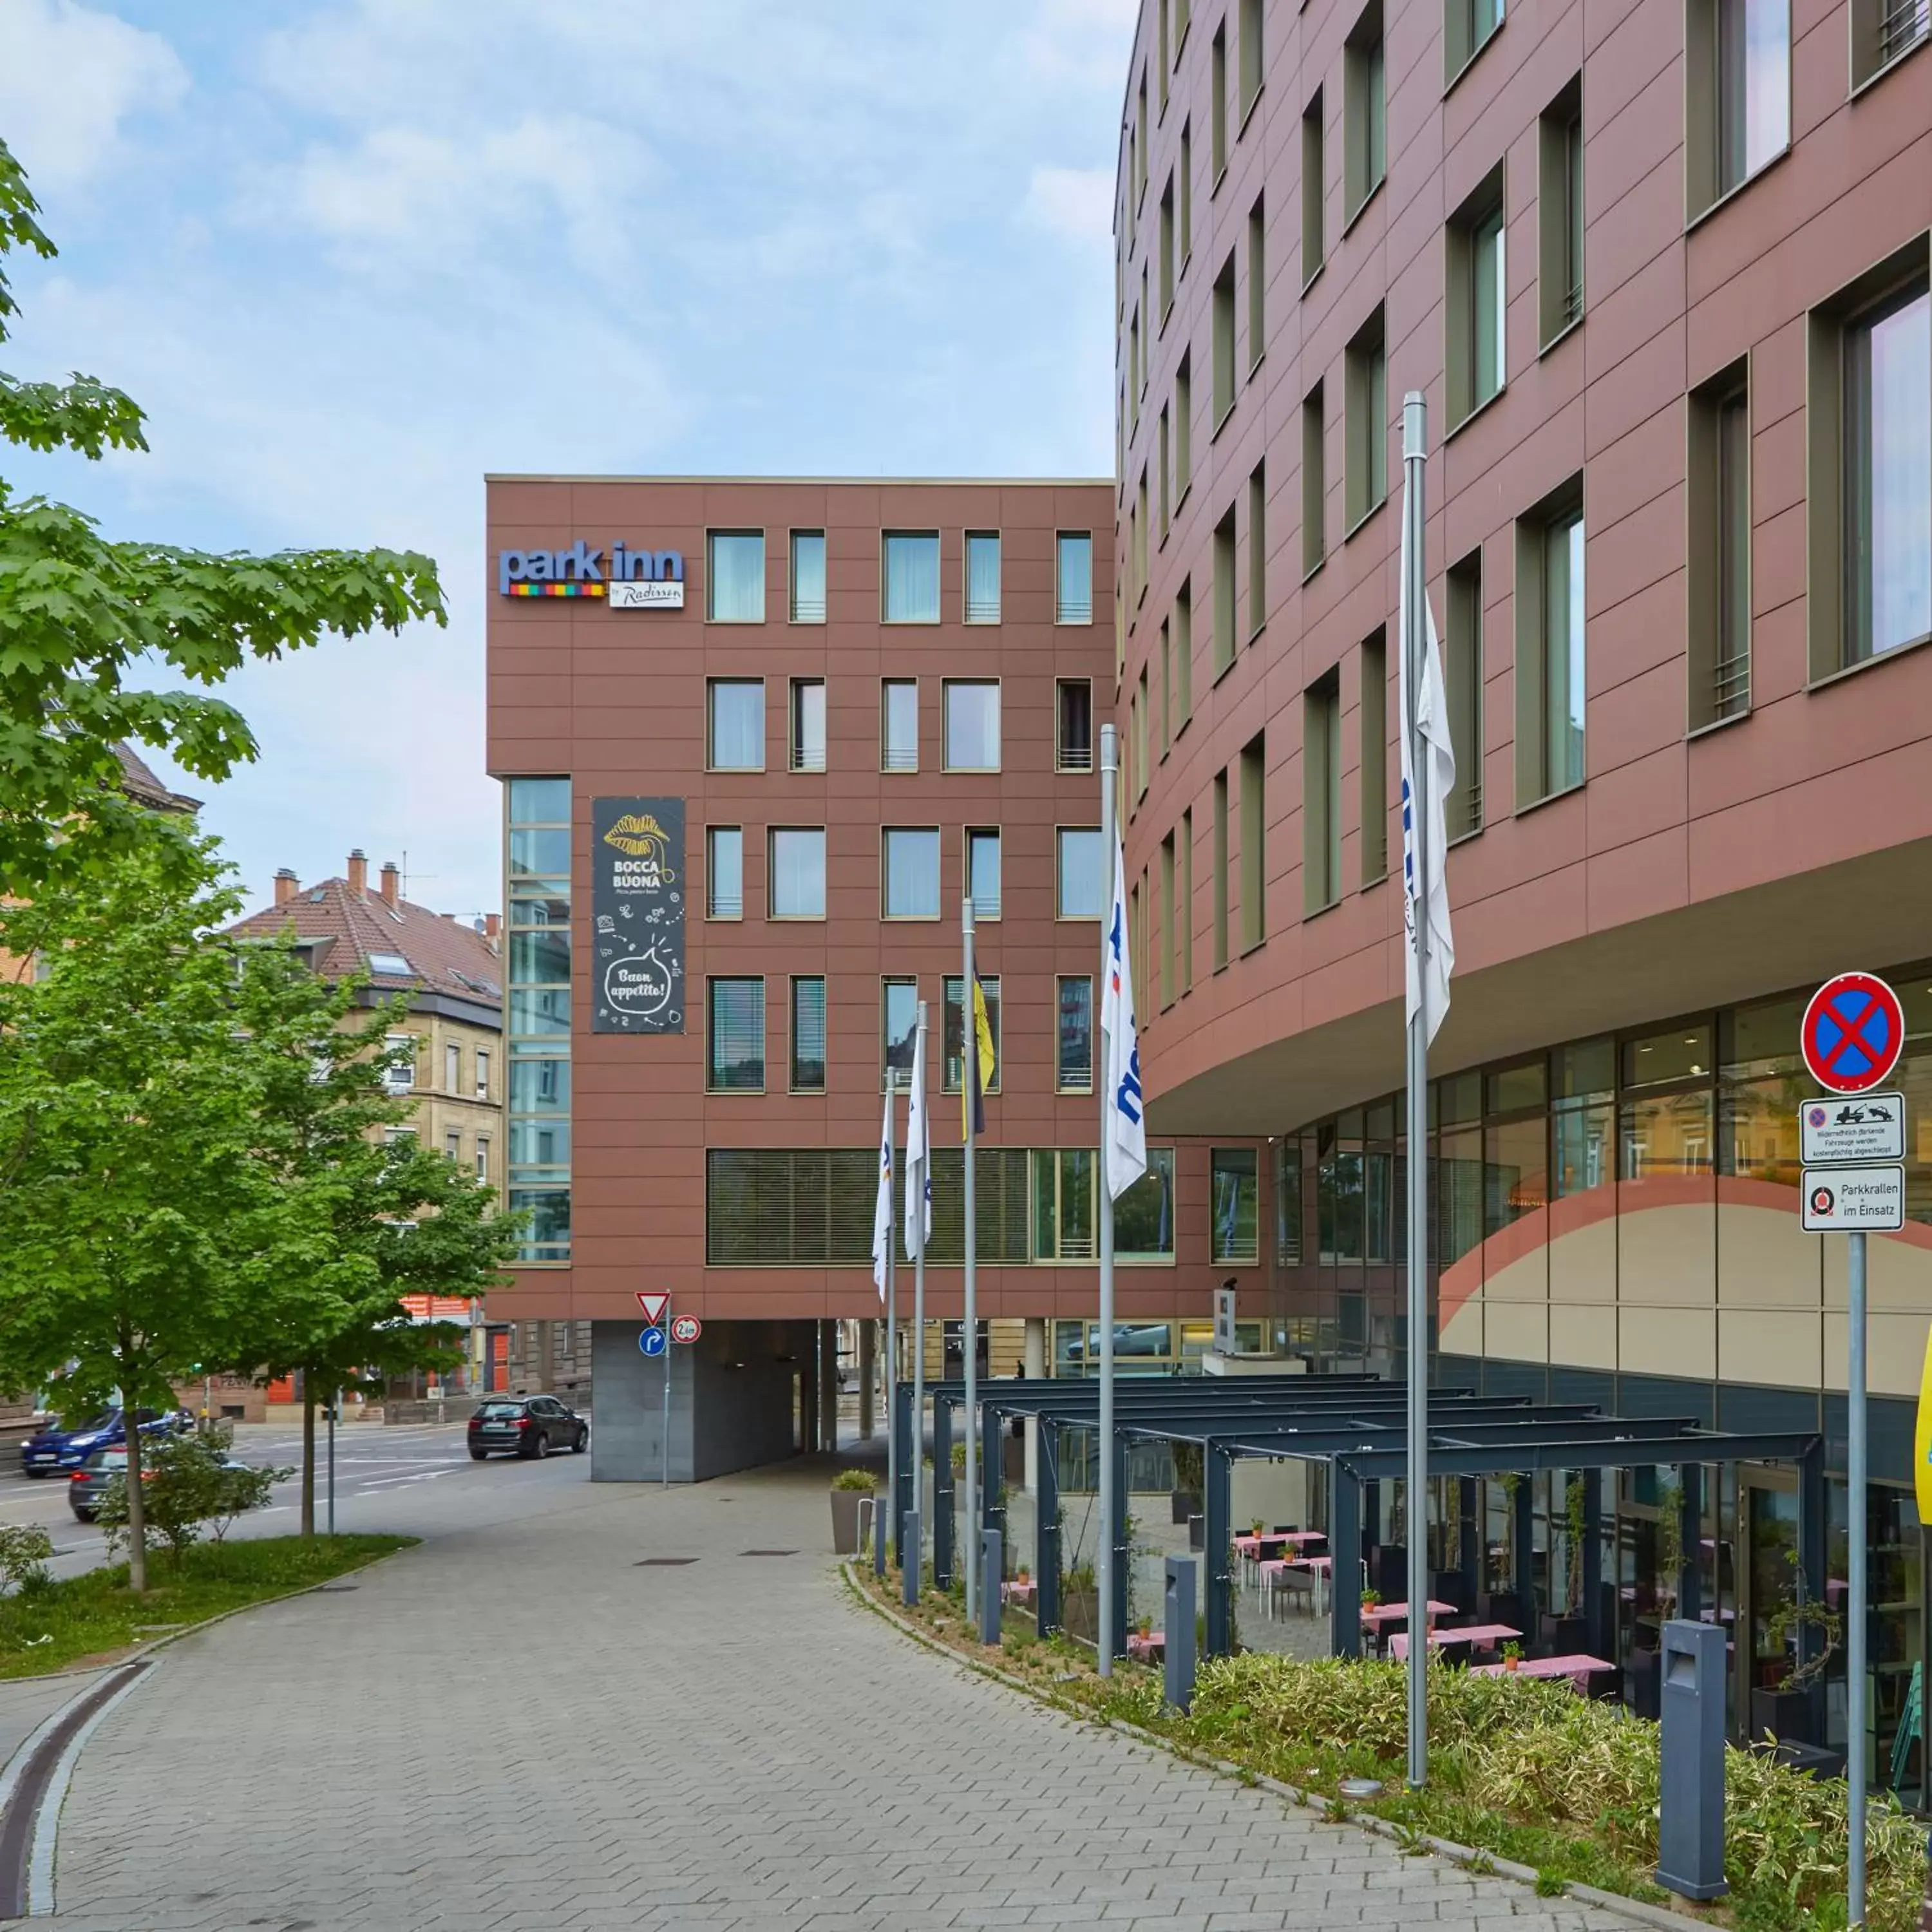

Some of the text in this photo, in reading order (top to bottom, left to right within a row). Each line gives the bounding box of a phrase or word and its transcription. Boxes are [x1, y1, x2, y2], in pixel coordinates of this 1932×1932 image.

[499, 540, 683, 596] park inn
[623, 583, 681, 605] Radisson
[614, 860, 659, 873] BOCCA
[613, 875, 661, 887] BUONA
[618, 969, 652, 982] Buon
[611, 983, 665, 1000] appetito!
[1842, 1182, 1898, 1195] Parkkrallen
[1844, 1205, 1895, 1216] im Einsatz
